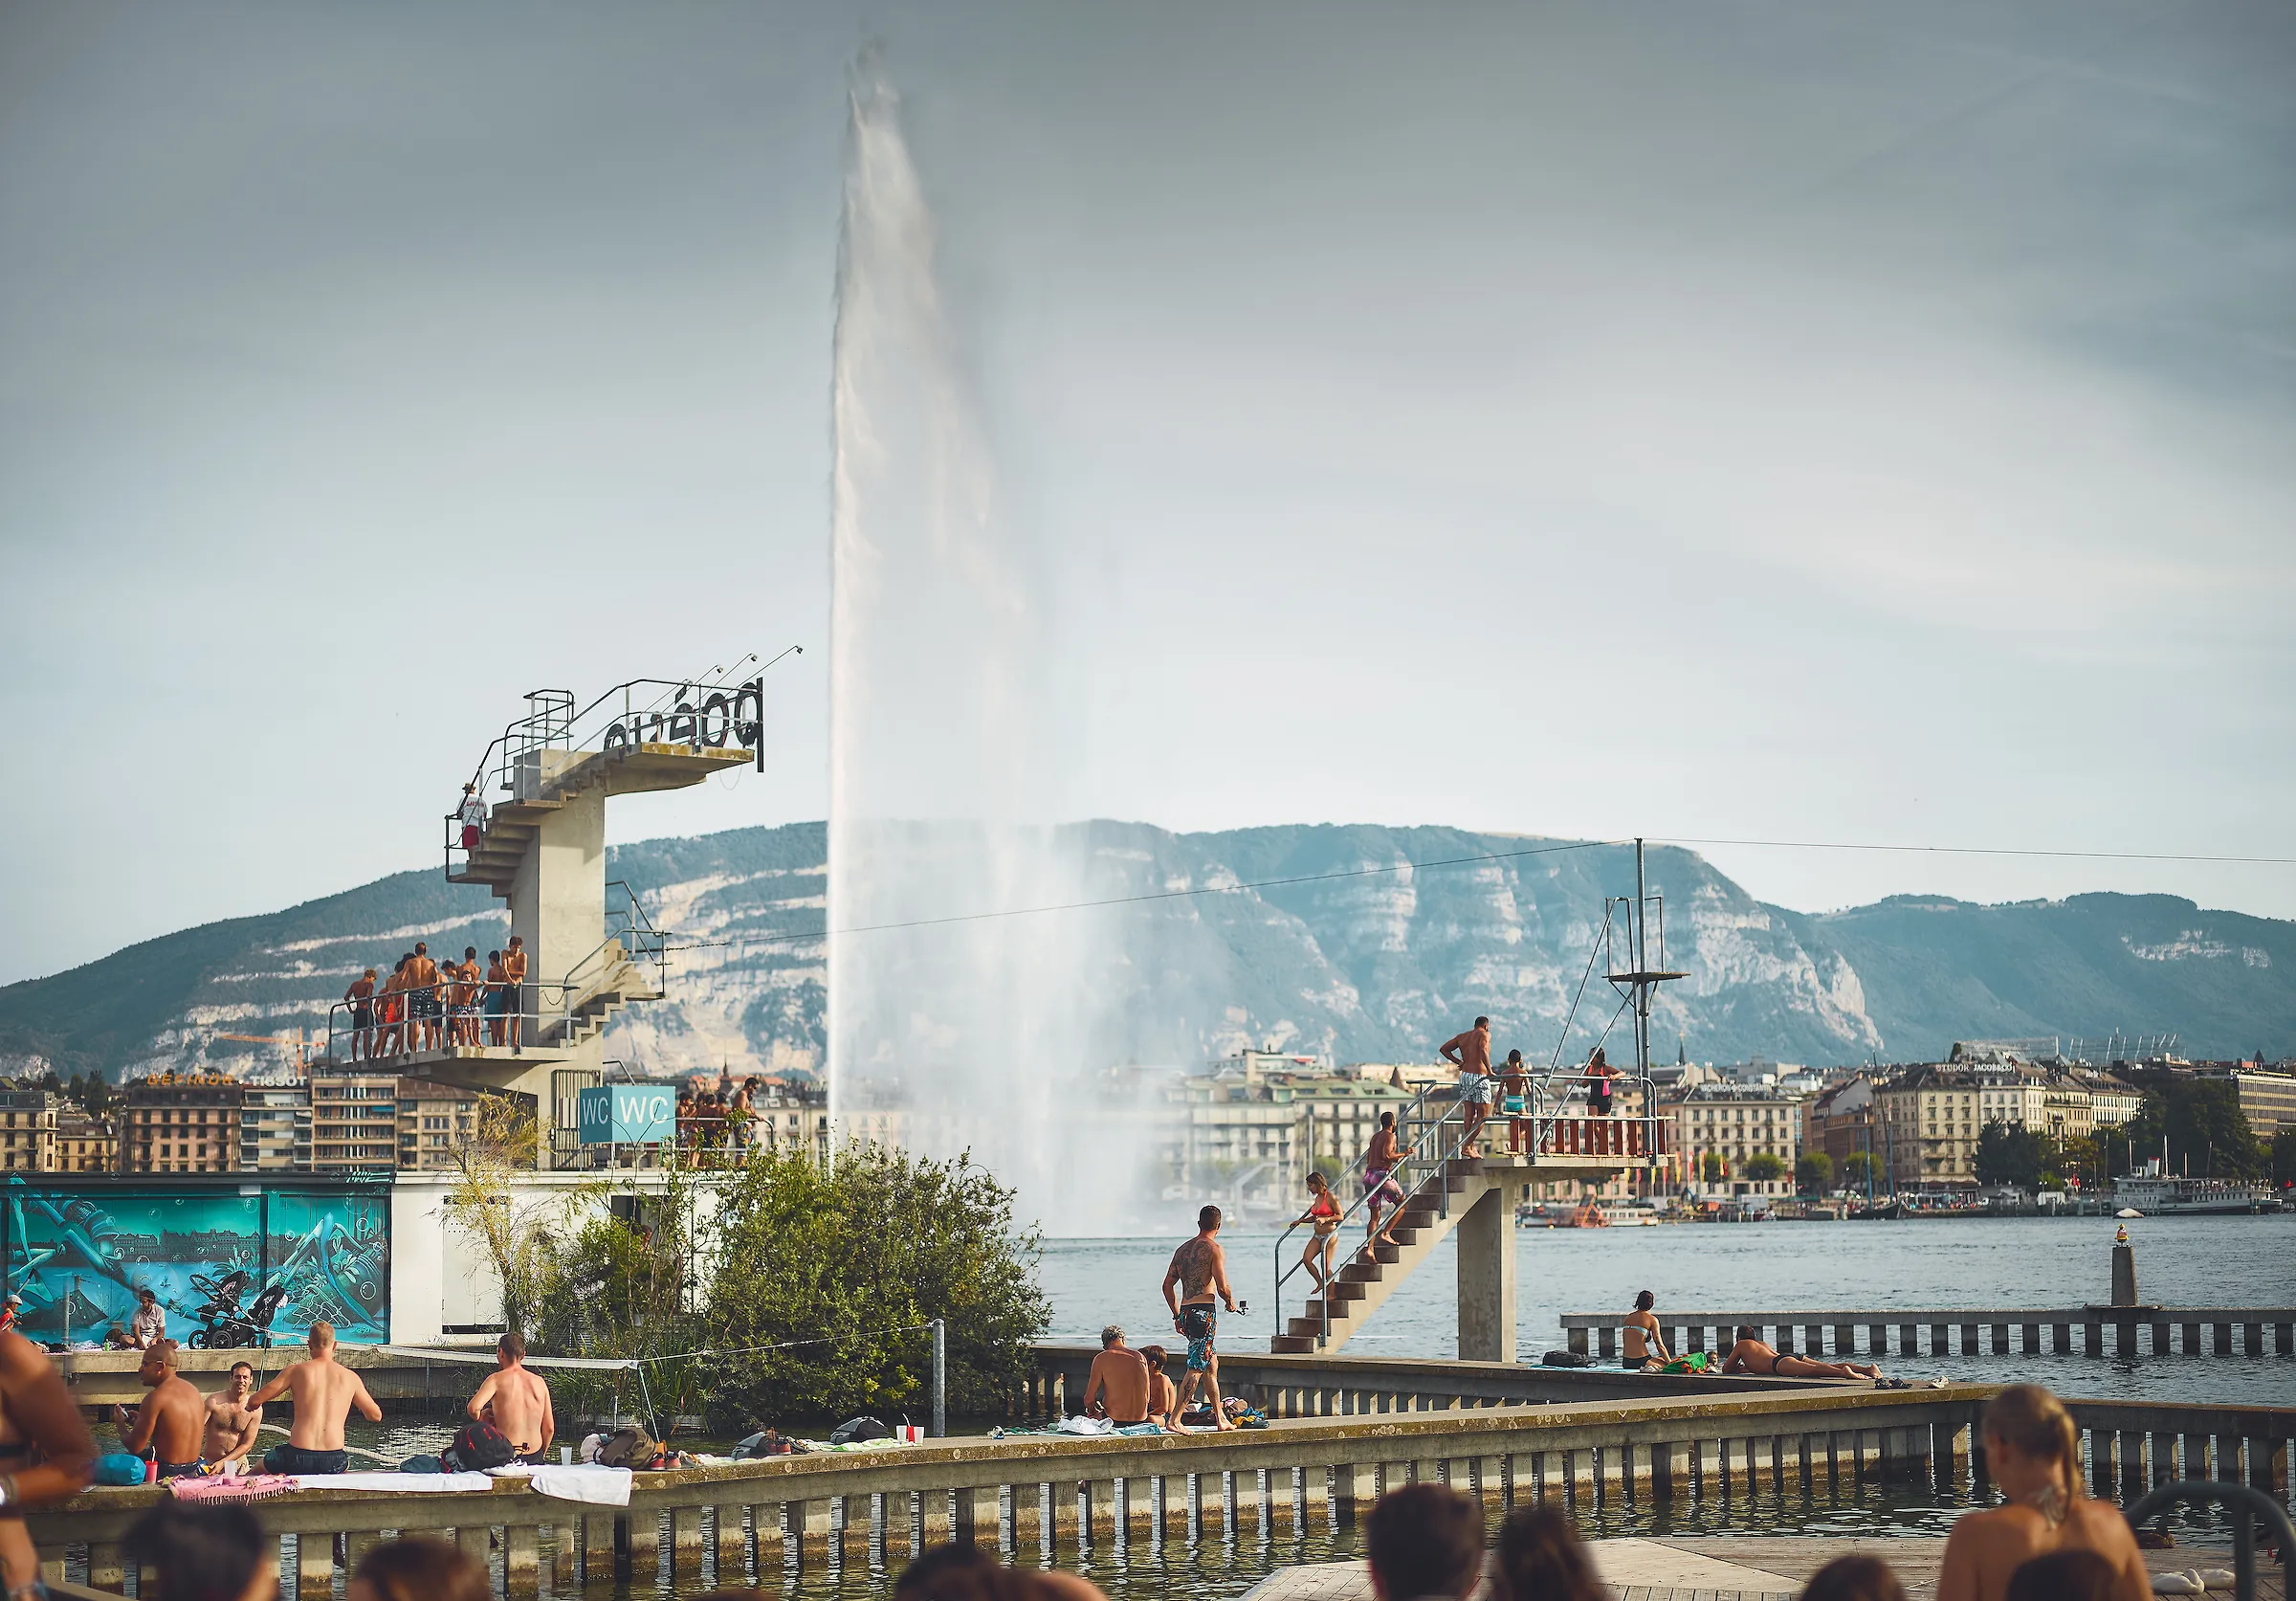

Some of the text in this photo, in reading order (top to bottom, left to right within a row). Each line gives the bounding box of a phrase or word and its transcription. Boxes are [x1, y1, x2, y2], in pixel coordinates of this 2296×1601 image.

[146, 1073, 234, 1087] GEFINOR
[250, 1075, 308, 1087] TISSOT
[582, 1096, 608, 1125] WC
[619, 1095, 668, 1124] WC
